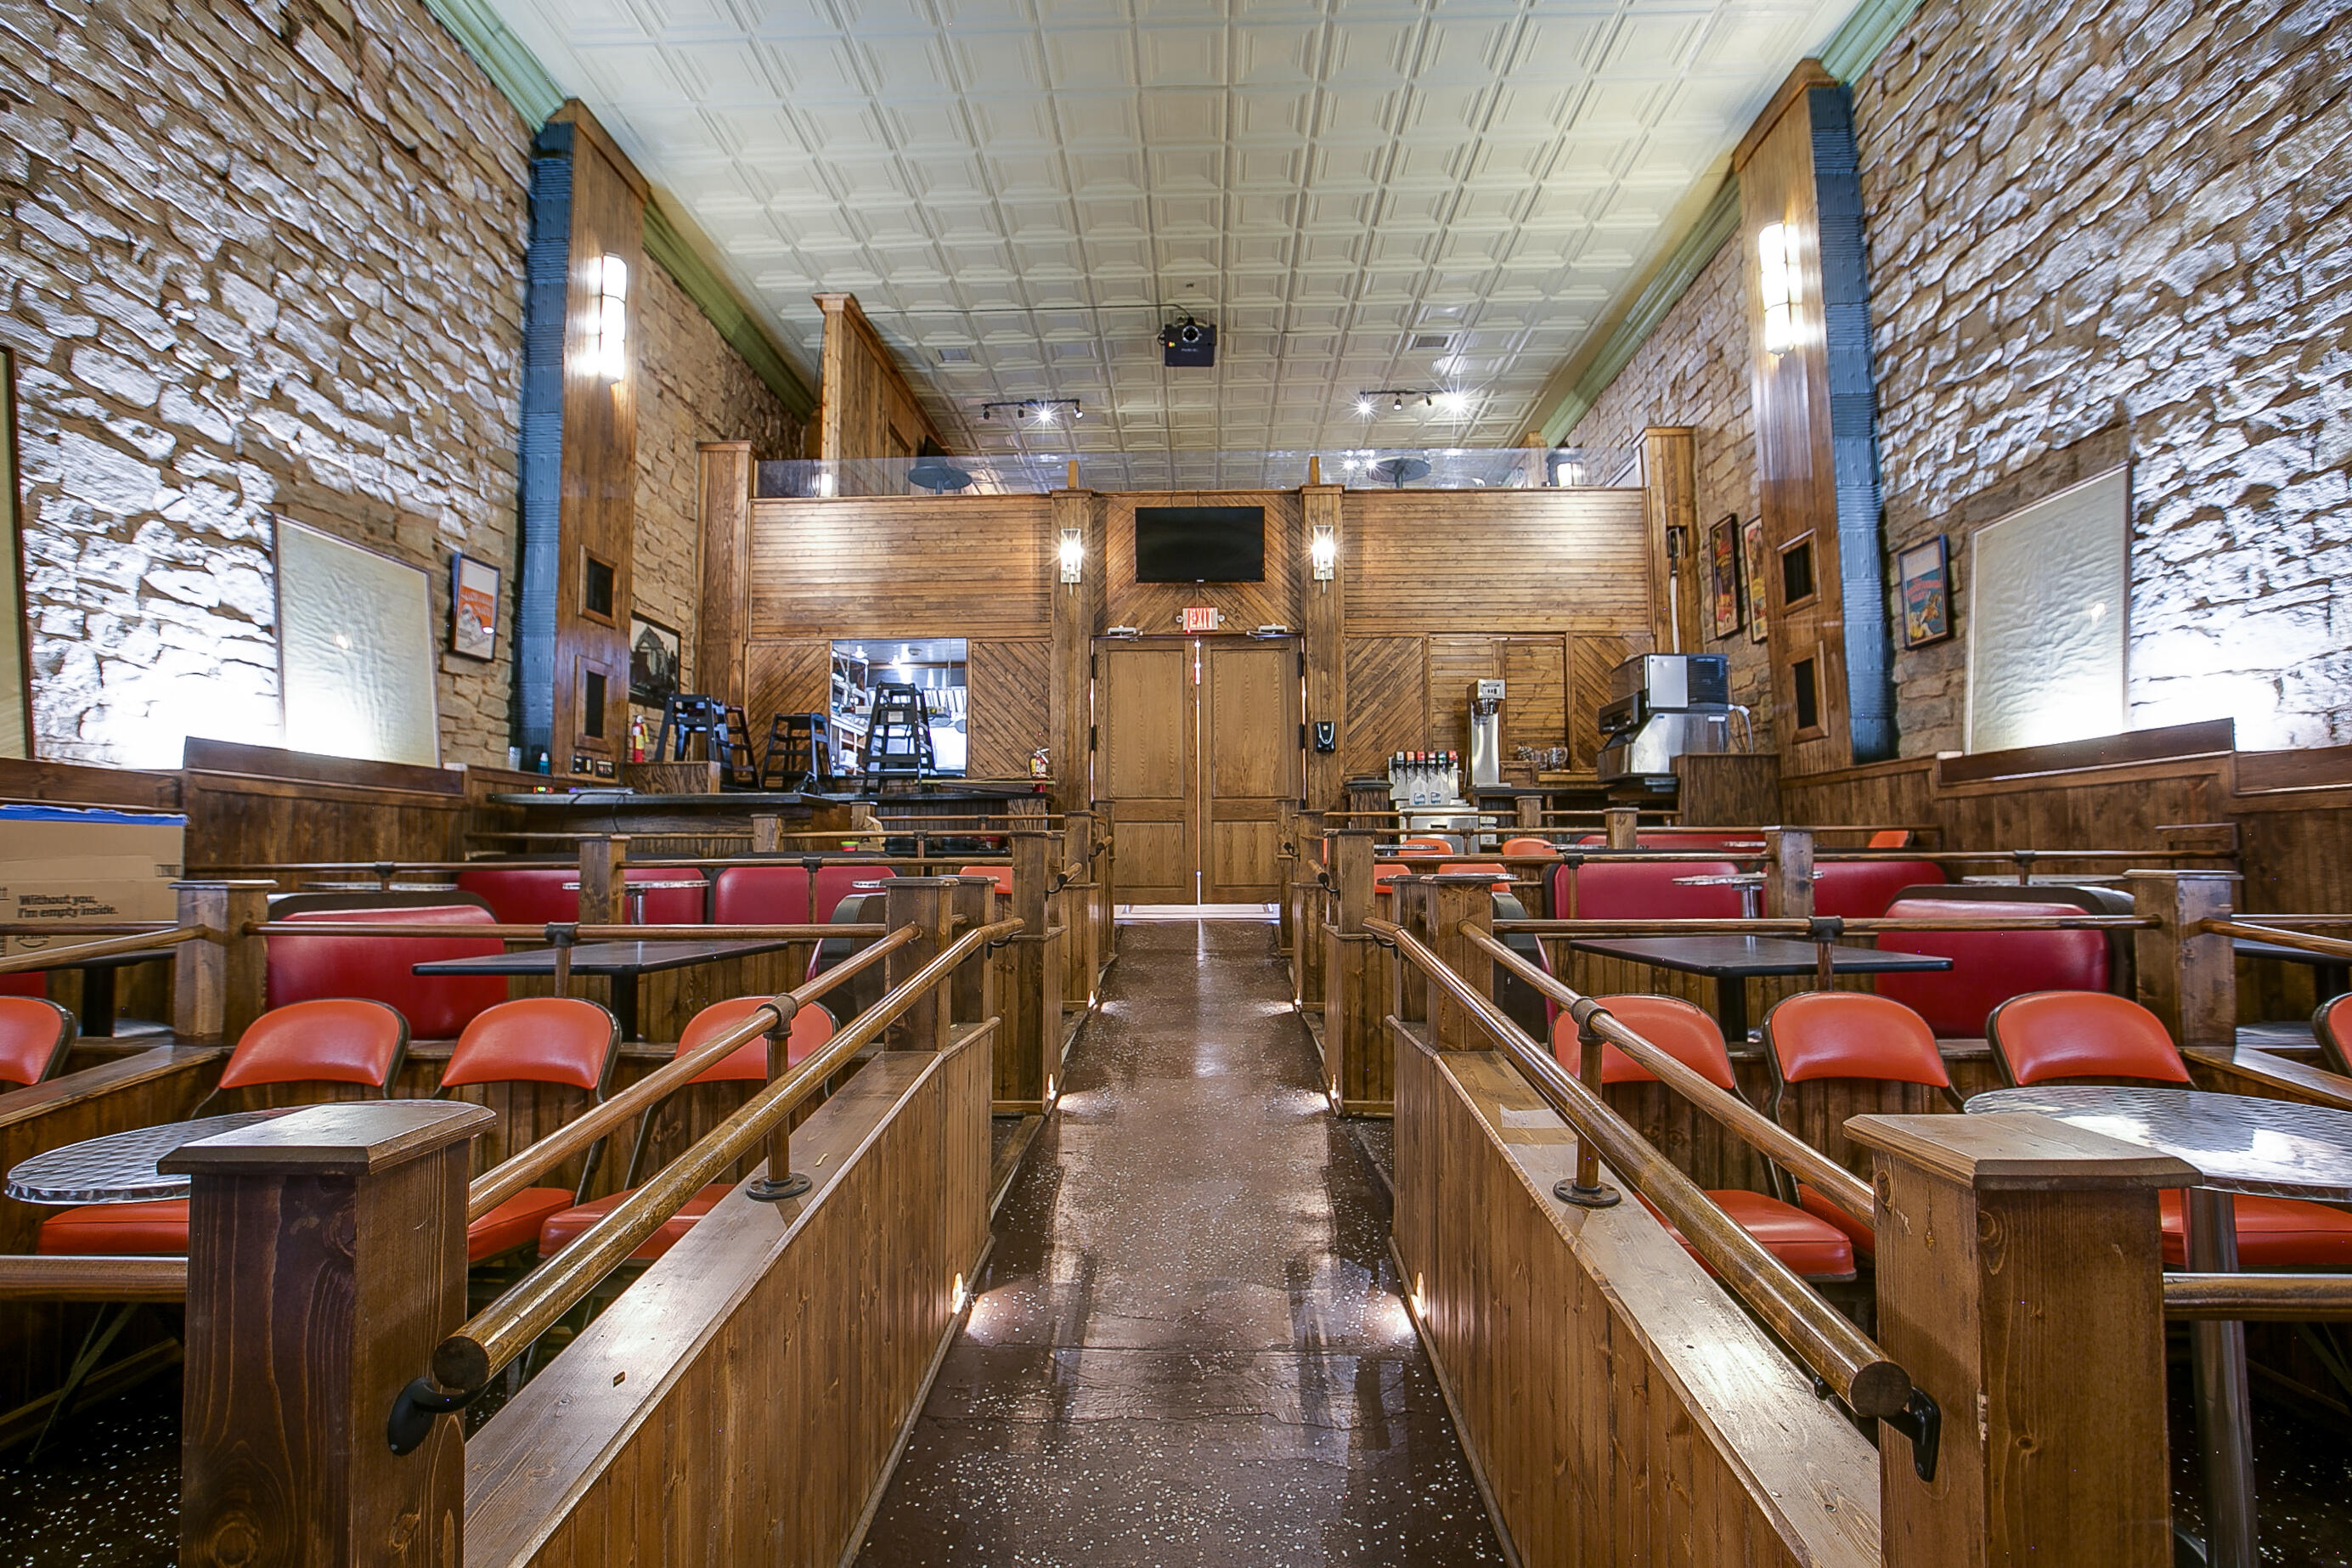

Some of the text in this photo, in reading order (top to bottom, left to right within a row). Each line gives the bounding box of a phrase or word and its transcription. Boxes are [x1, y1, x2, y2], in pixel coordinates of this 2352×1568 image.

[1188, 608, 1213, 629] EXIT
[19, 894, 71, 905] Without
[17, 905, 119, 918] I'm empty inside.
